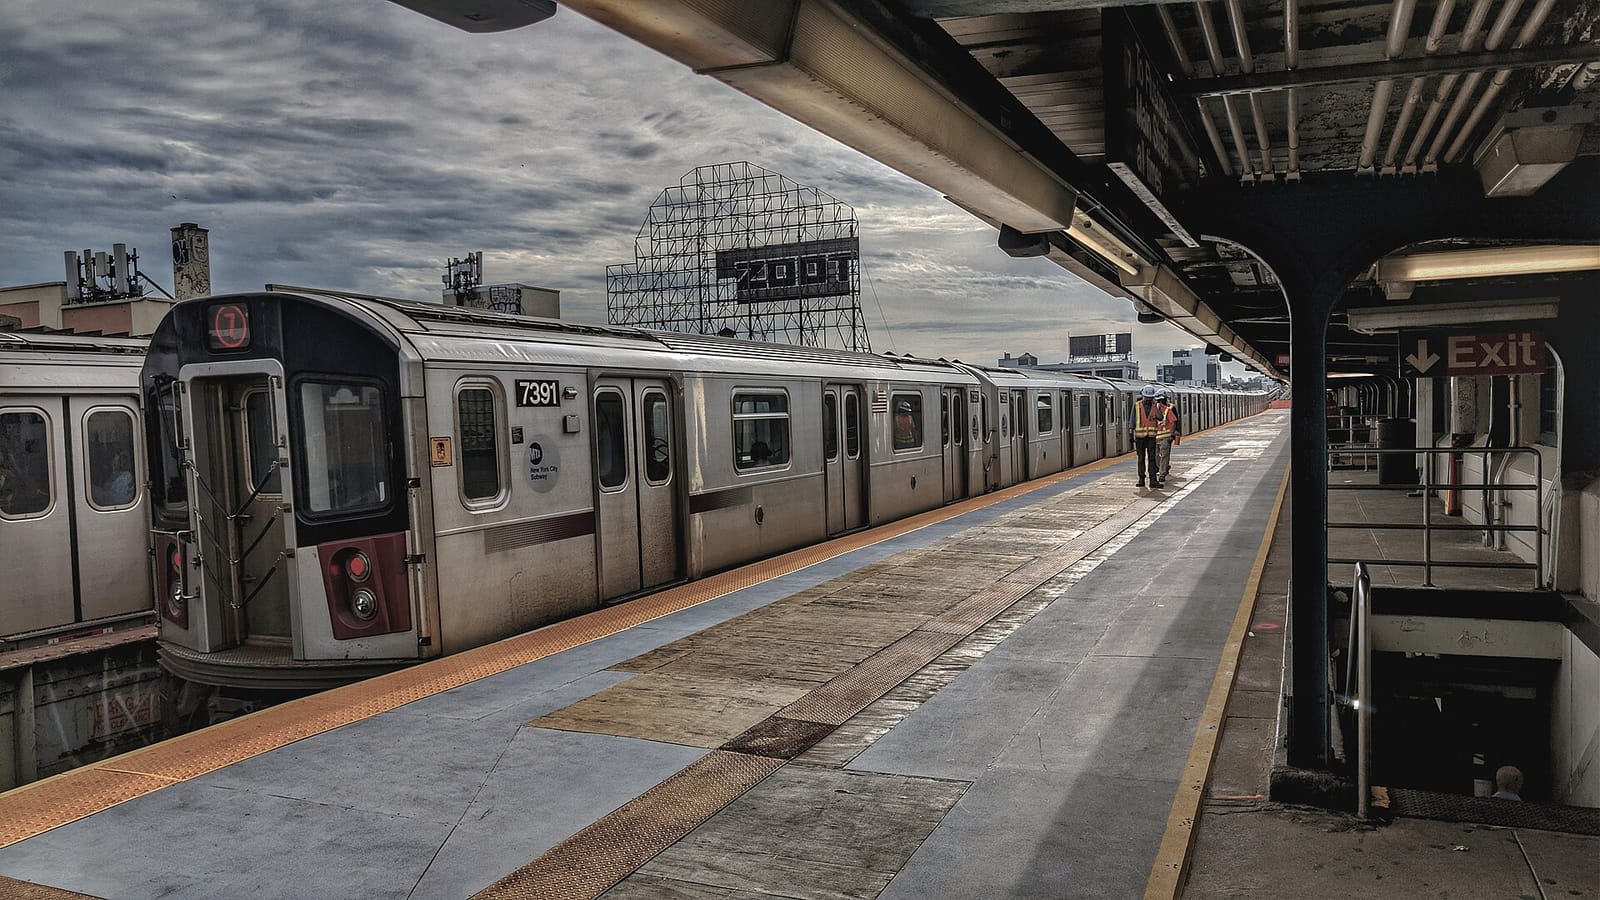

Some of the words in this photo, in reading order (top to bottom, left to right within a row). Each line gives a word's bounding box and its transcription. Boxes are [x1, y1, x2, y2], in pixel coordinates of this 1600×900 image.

[224, 313, 235, 337] 7
[1448, 333, 1537, 368] Exit
[519, 382, 557, 405] 7391
[529, 447, 541, 461] MTA
[550, 465, 558, 473] City
